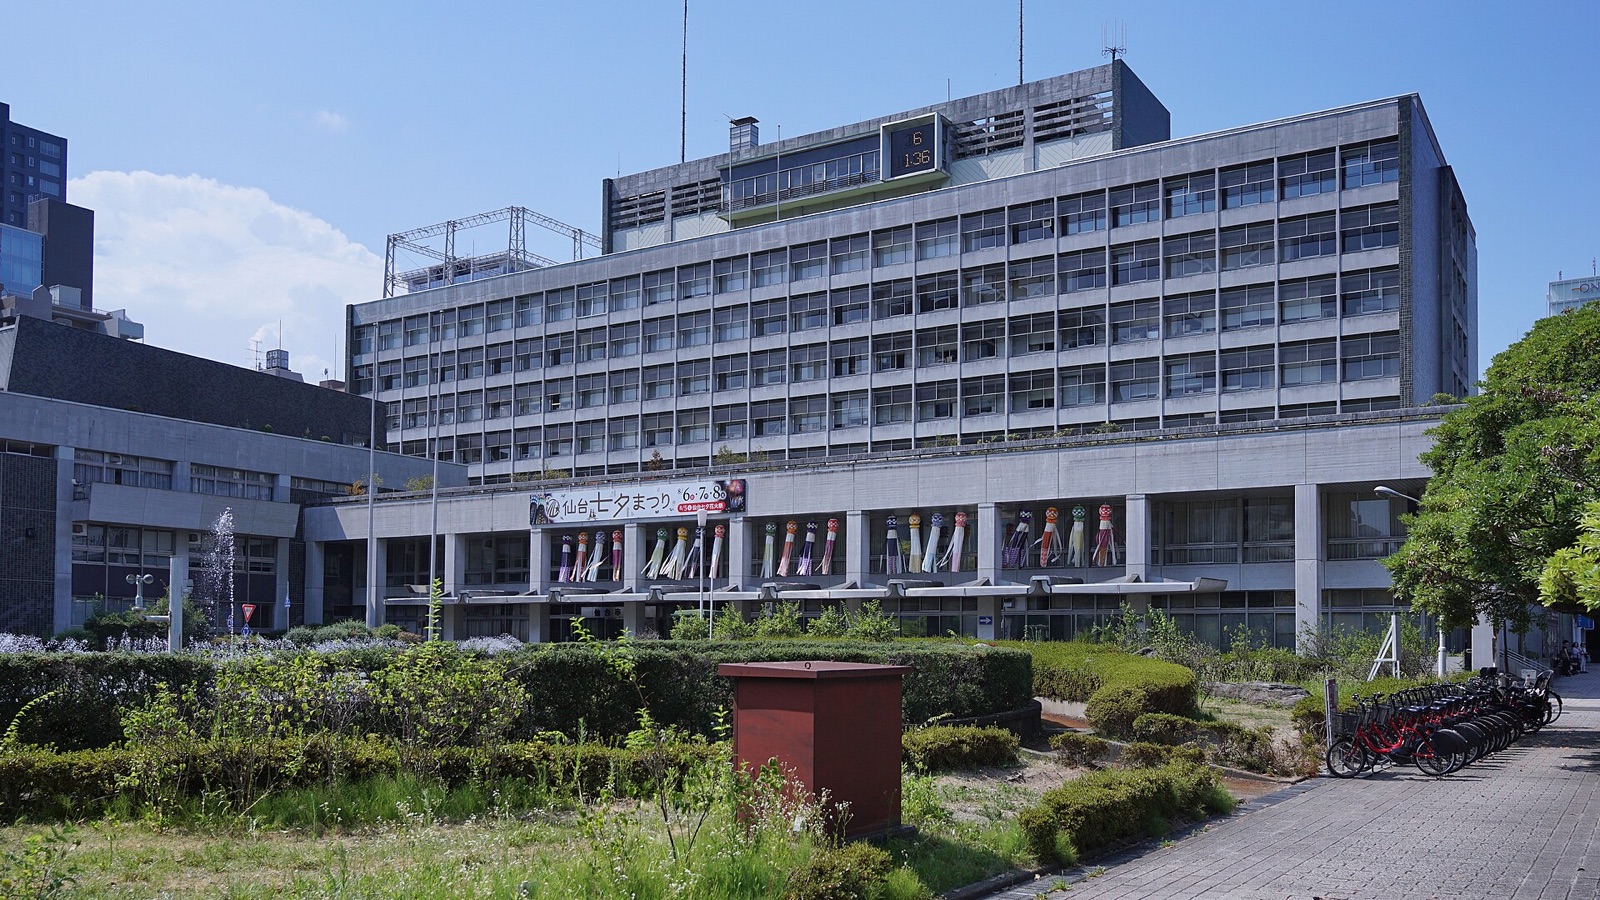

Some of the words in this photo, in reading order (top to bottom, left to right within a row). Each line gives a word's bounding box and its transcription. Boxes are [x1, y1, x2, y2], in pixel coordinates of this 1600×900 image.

[913, 131, 922, 146] 6
[562, 491, 670, 518] 仙台七夕まつり
